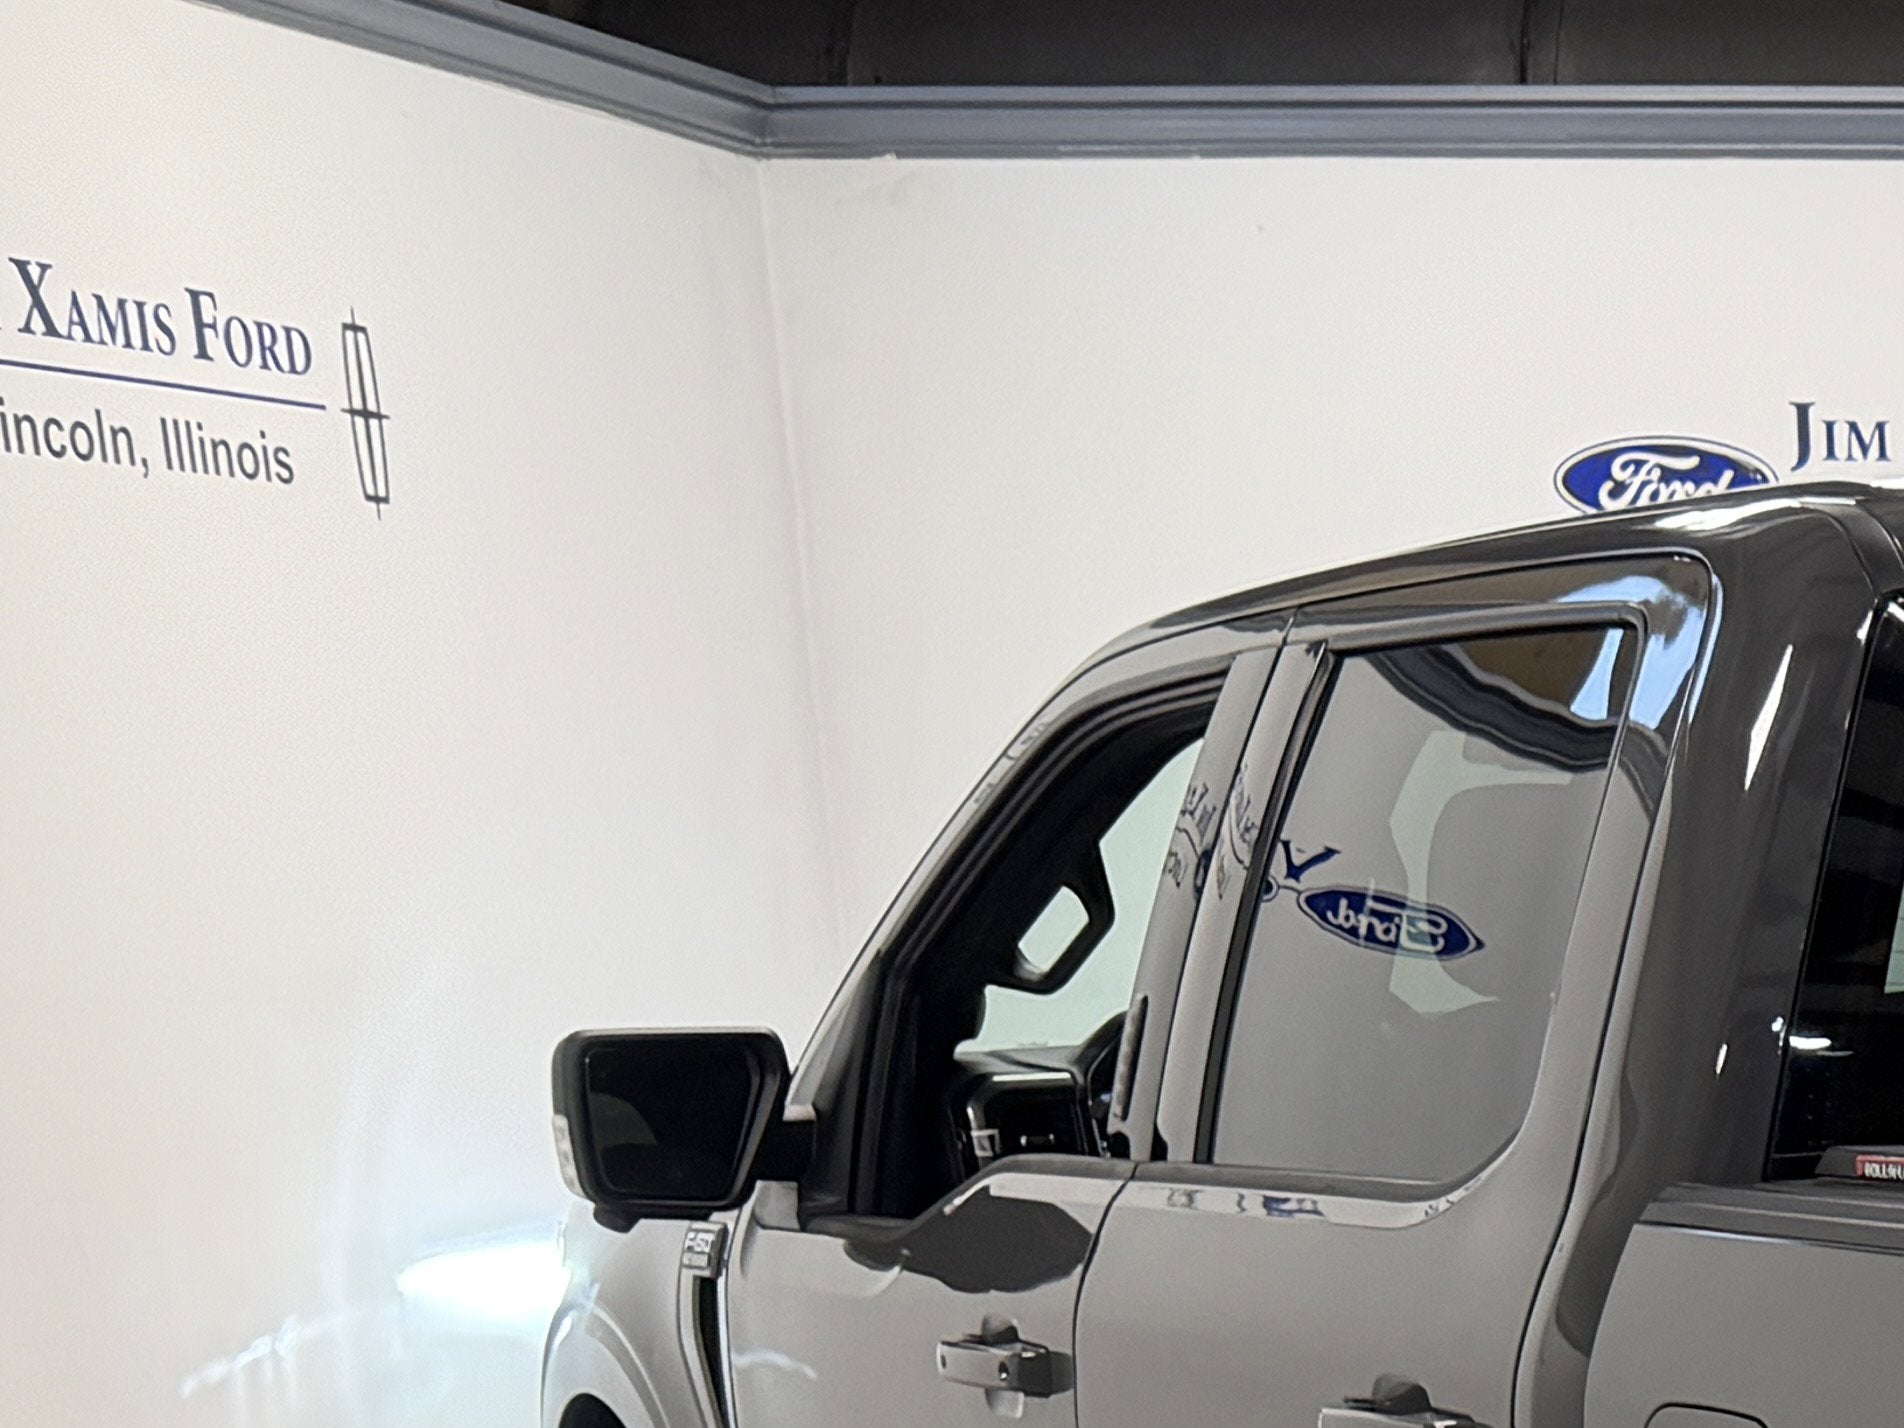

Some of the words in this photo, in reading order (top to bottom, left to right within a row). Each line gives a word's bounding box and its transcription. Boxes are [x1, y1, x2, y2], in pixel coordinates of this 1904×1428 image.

[8, 257, 177, 356] XAMIS
[184, 287, 312, 375] FORD
[0, 395, 149, 478] incoln,
[160, 417, 294, 484] Illinois
[1789, 401, 1890, 473] JIM
